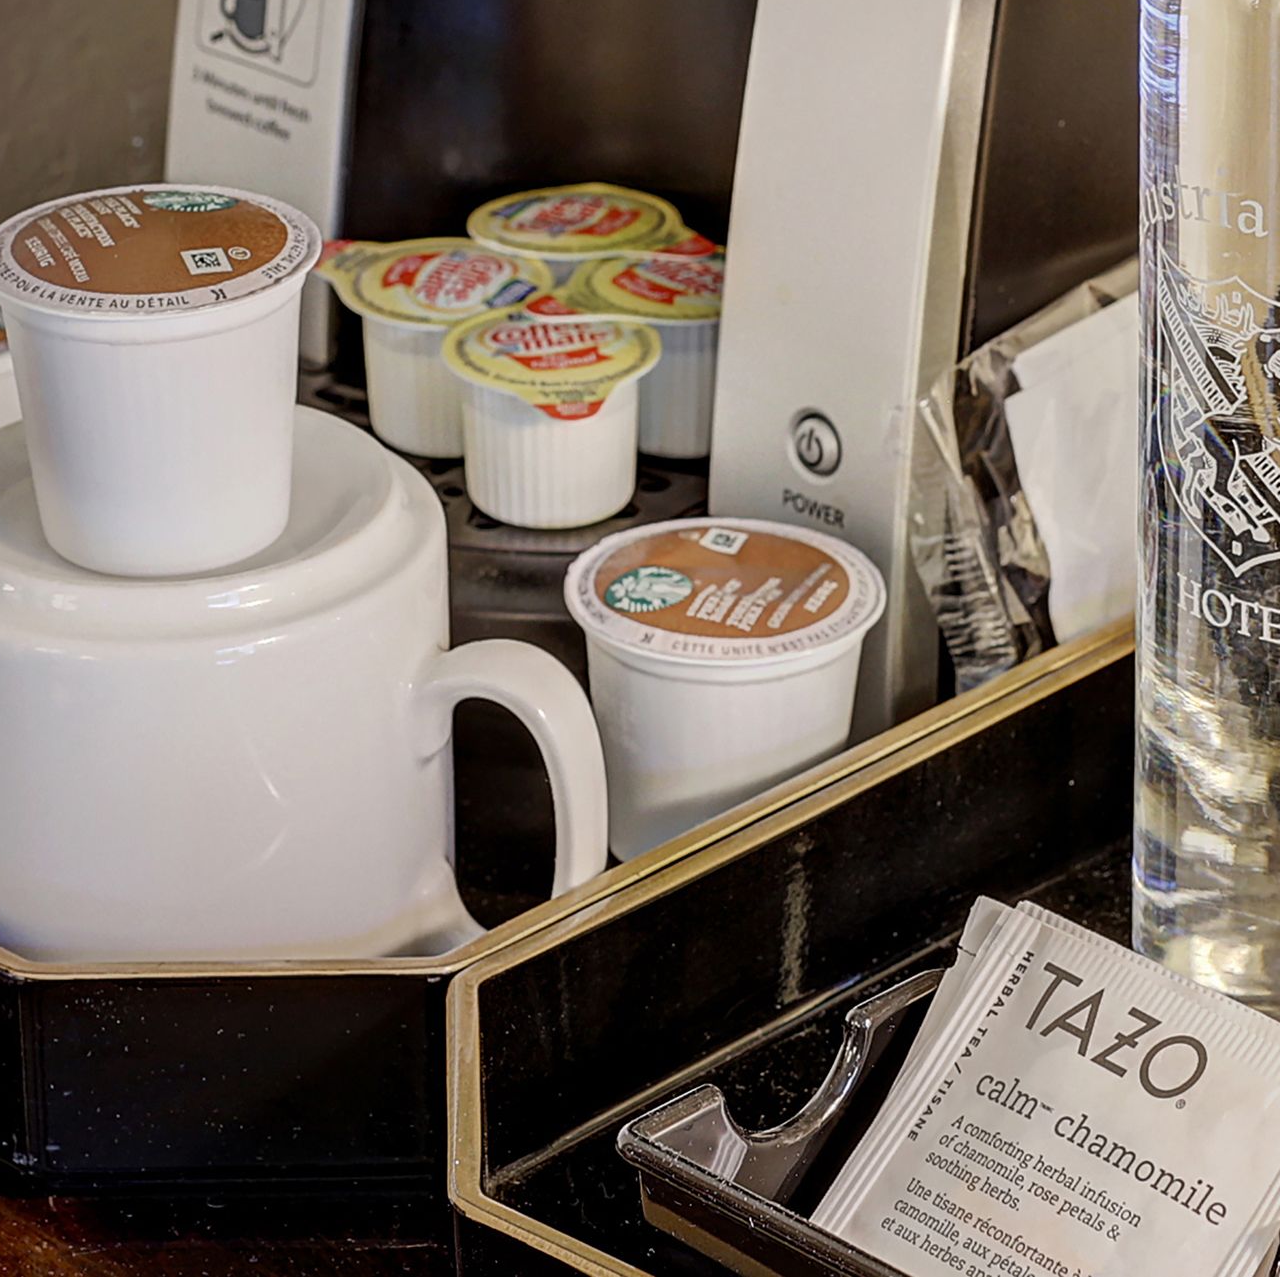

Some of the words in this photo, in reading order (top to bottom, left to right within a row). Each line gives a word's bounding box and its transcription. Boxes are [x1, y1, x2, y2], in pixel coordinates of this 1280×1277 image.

[40, 287, 56, 301] LA
[59, 293, 104, 309] VENTE
[108, 298, 129, 309] AU
[136, 296, 191, 310] DÉTAIL
[782, 488, 846, 530] POWER
[671, 642, 716, 656] CETTE
[986, 950, 1035, 1018] HERBAL
[960, 1026, 988, 1059] TEA
[907, 1079, 954, 1142] TISANE
[924, 1150, 982, 1193] soothing
[979, 1175, 1022, 1212] herbs.
[938, 1133, 959, 1149] of
[953, 1139, 1026, 1191] chamomile,
[1027, 1180, 1061, 1207] rose
[1056, 1199, 1106, 1233] petals
[1106, 1223, 1122, 1243] &
[950, 1114, 965, 1131] A
[963, 1121, 1035, 1170] comforting
[1032, 1155, 1082, 1192] herbal
[1079, 1180, 1142, 1229] infusion
[1053, 1113, 1228, 1226] chamomile
[880, 1215, 896, 1230] et
[893, 1223, 921, 1245] aux
[919, 1234, 968, 1272] herbes
[893, 1198, 961, 1245] camomille,
[962, 1236, 991, 1261] aux
[905, 1177, 934, 1202] Une
[931, 1191, 975, 1225] tisane
[971, 1217, 1070, 1277] réconfortante
